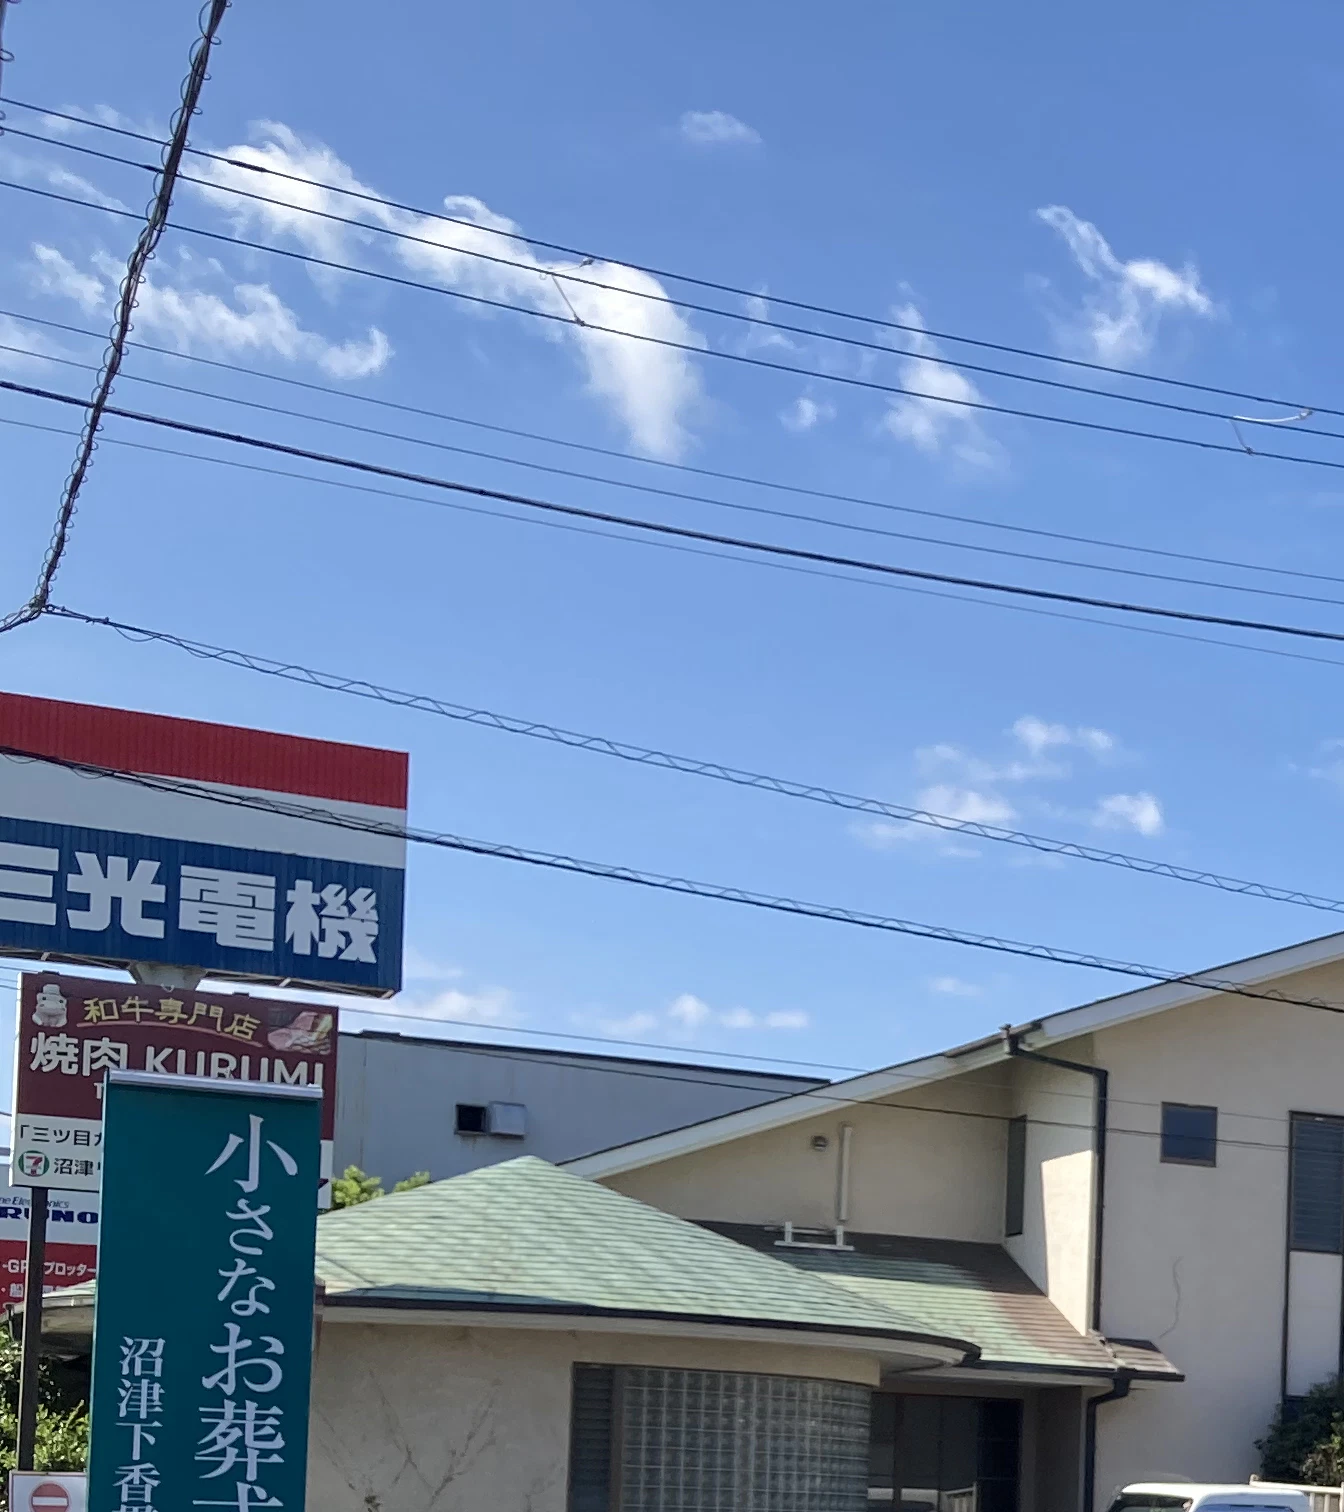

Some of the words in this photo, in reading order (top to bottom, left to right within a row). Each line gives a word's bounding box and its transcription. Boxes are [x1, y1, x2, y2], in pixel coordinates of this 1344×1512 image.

[0, 842, 380, 964] 三光電機
[83, 995, 263, 1040] 和牛専門店
[30, 1031, 129, 1077] 焼肉
[145, 1045, 325, 1088] KURUMI
[53, 1157, 101, 1176] 沼津
